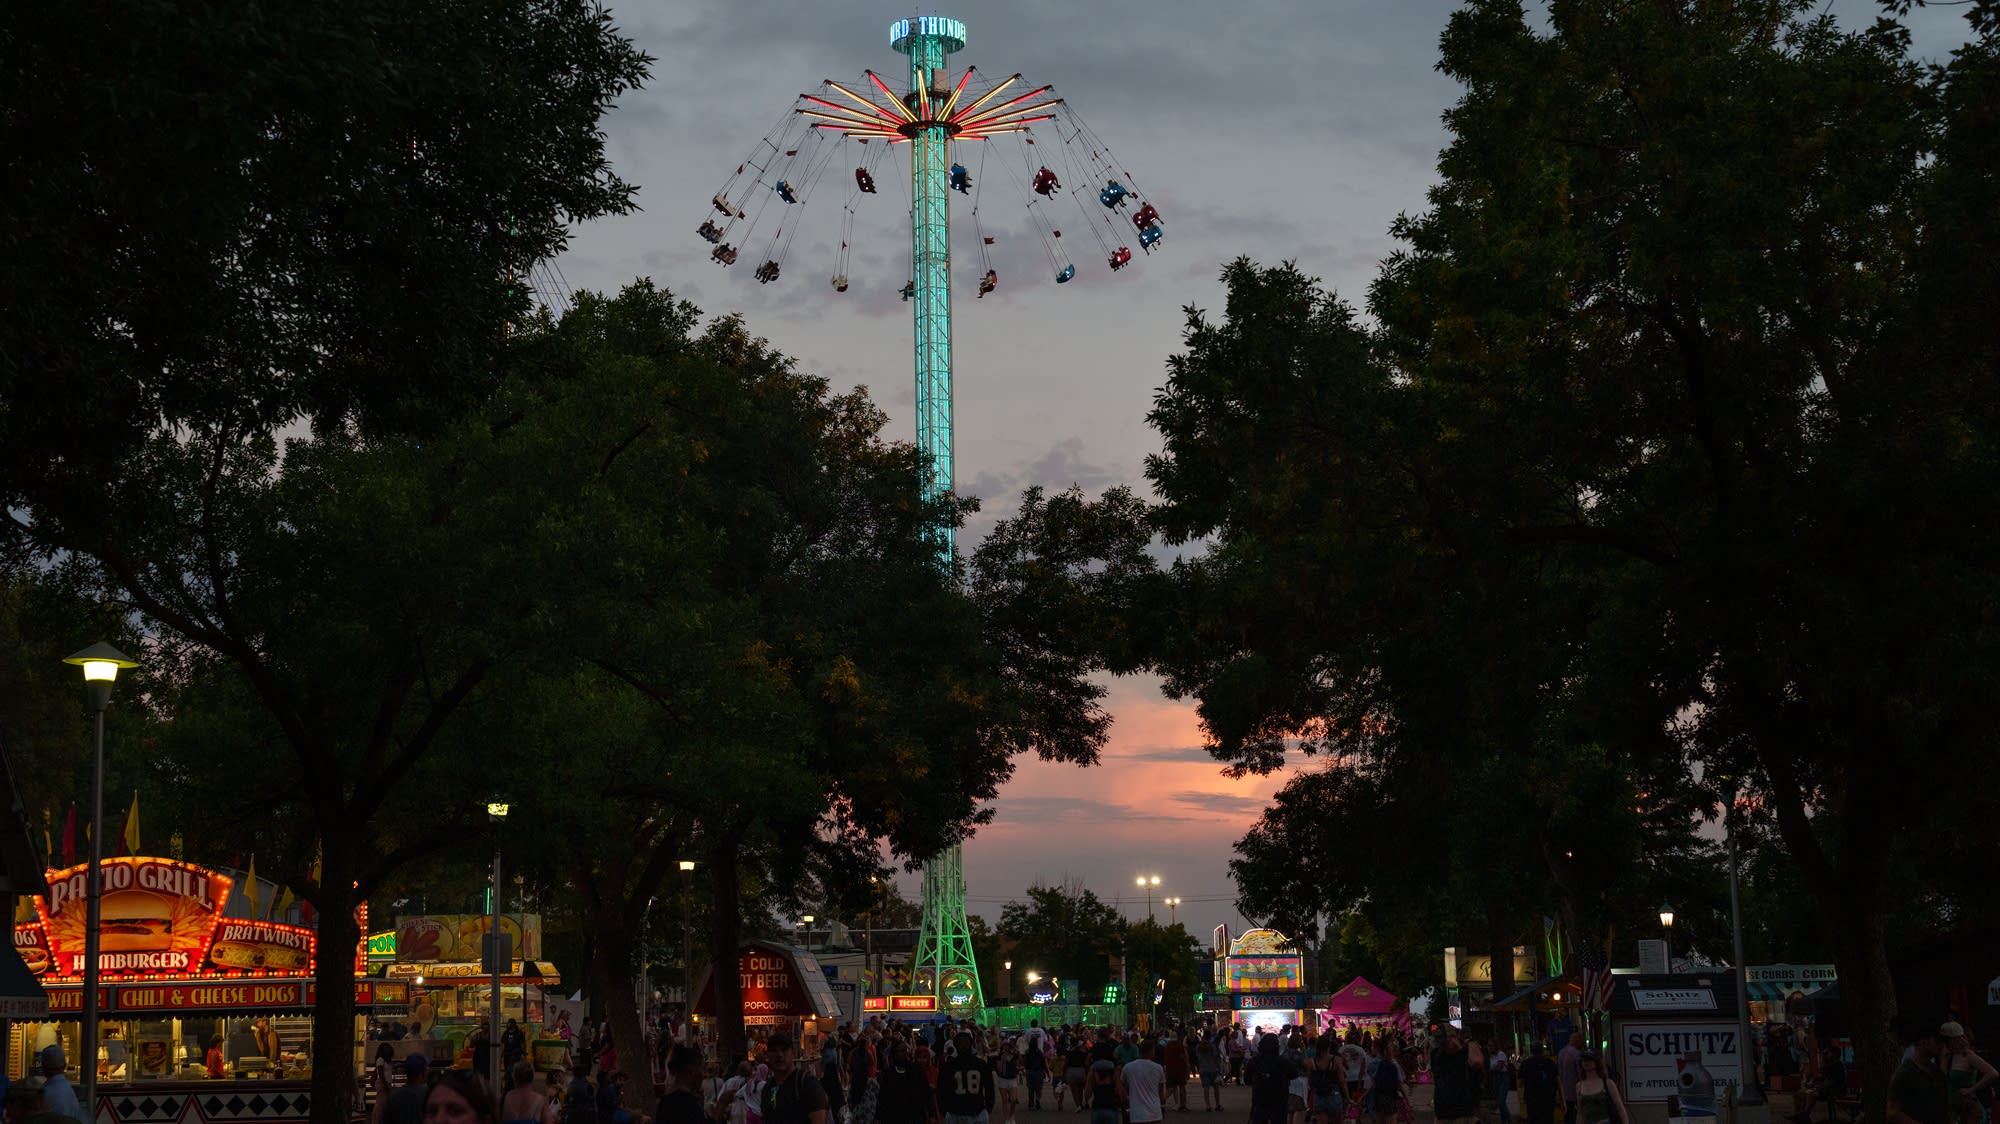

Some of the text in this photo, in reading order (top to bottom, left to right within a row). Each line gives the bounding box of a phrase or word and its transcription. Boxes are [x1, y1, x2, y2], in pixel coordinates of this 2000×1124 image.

[138, 863, 214, 911] GRILL
[14, 929, 38, 946] OGS
[222, 924, 309, 951] BRATWURST
[72, 951, 190, 970] HMBURGERS
[750, 957, 784, 971] COLD
[756, 973, 789, 989] BEER
[1761, 969, 1795, 980] CURDS
[1802, 968, 1835, 979] CORN
[122, 989, 166, 1007] CHILI
[170, 989, 185, 1006] &
[191, 987, 248, 1006] CHEESE
[254, 985, 295, 1003] DOGS
[898, 998, 930, 1008] TICKETS
[1240, 995, 1297, 1008] FLOATS
[744, 1001, 789, 1010] POPCORN
[1628, 1031, 1736, 1056] SCHUTZ
[953, 1069, 981, 1095] 18
[1630, 1079, 1642, 1089] for
